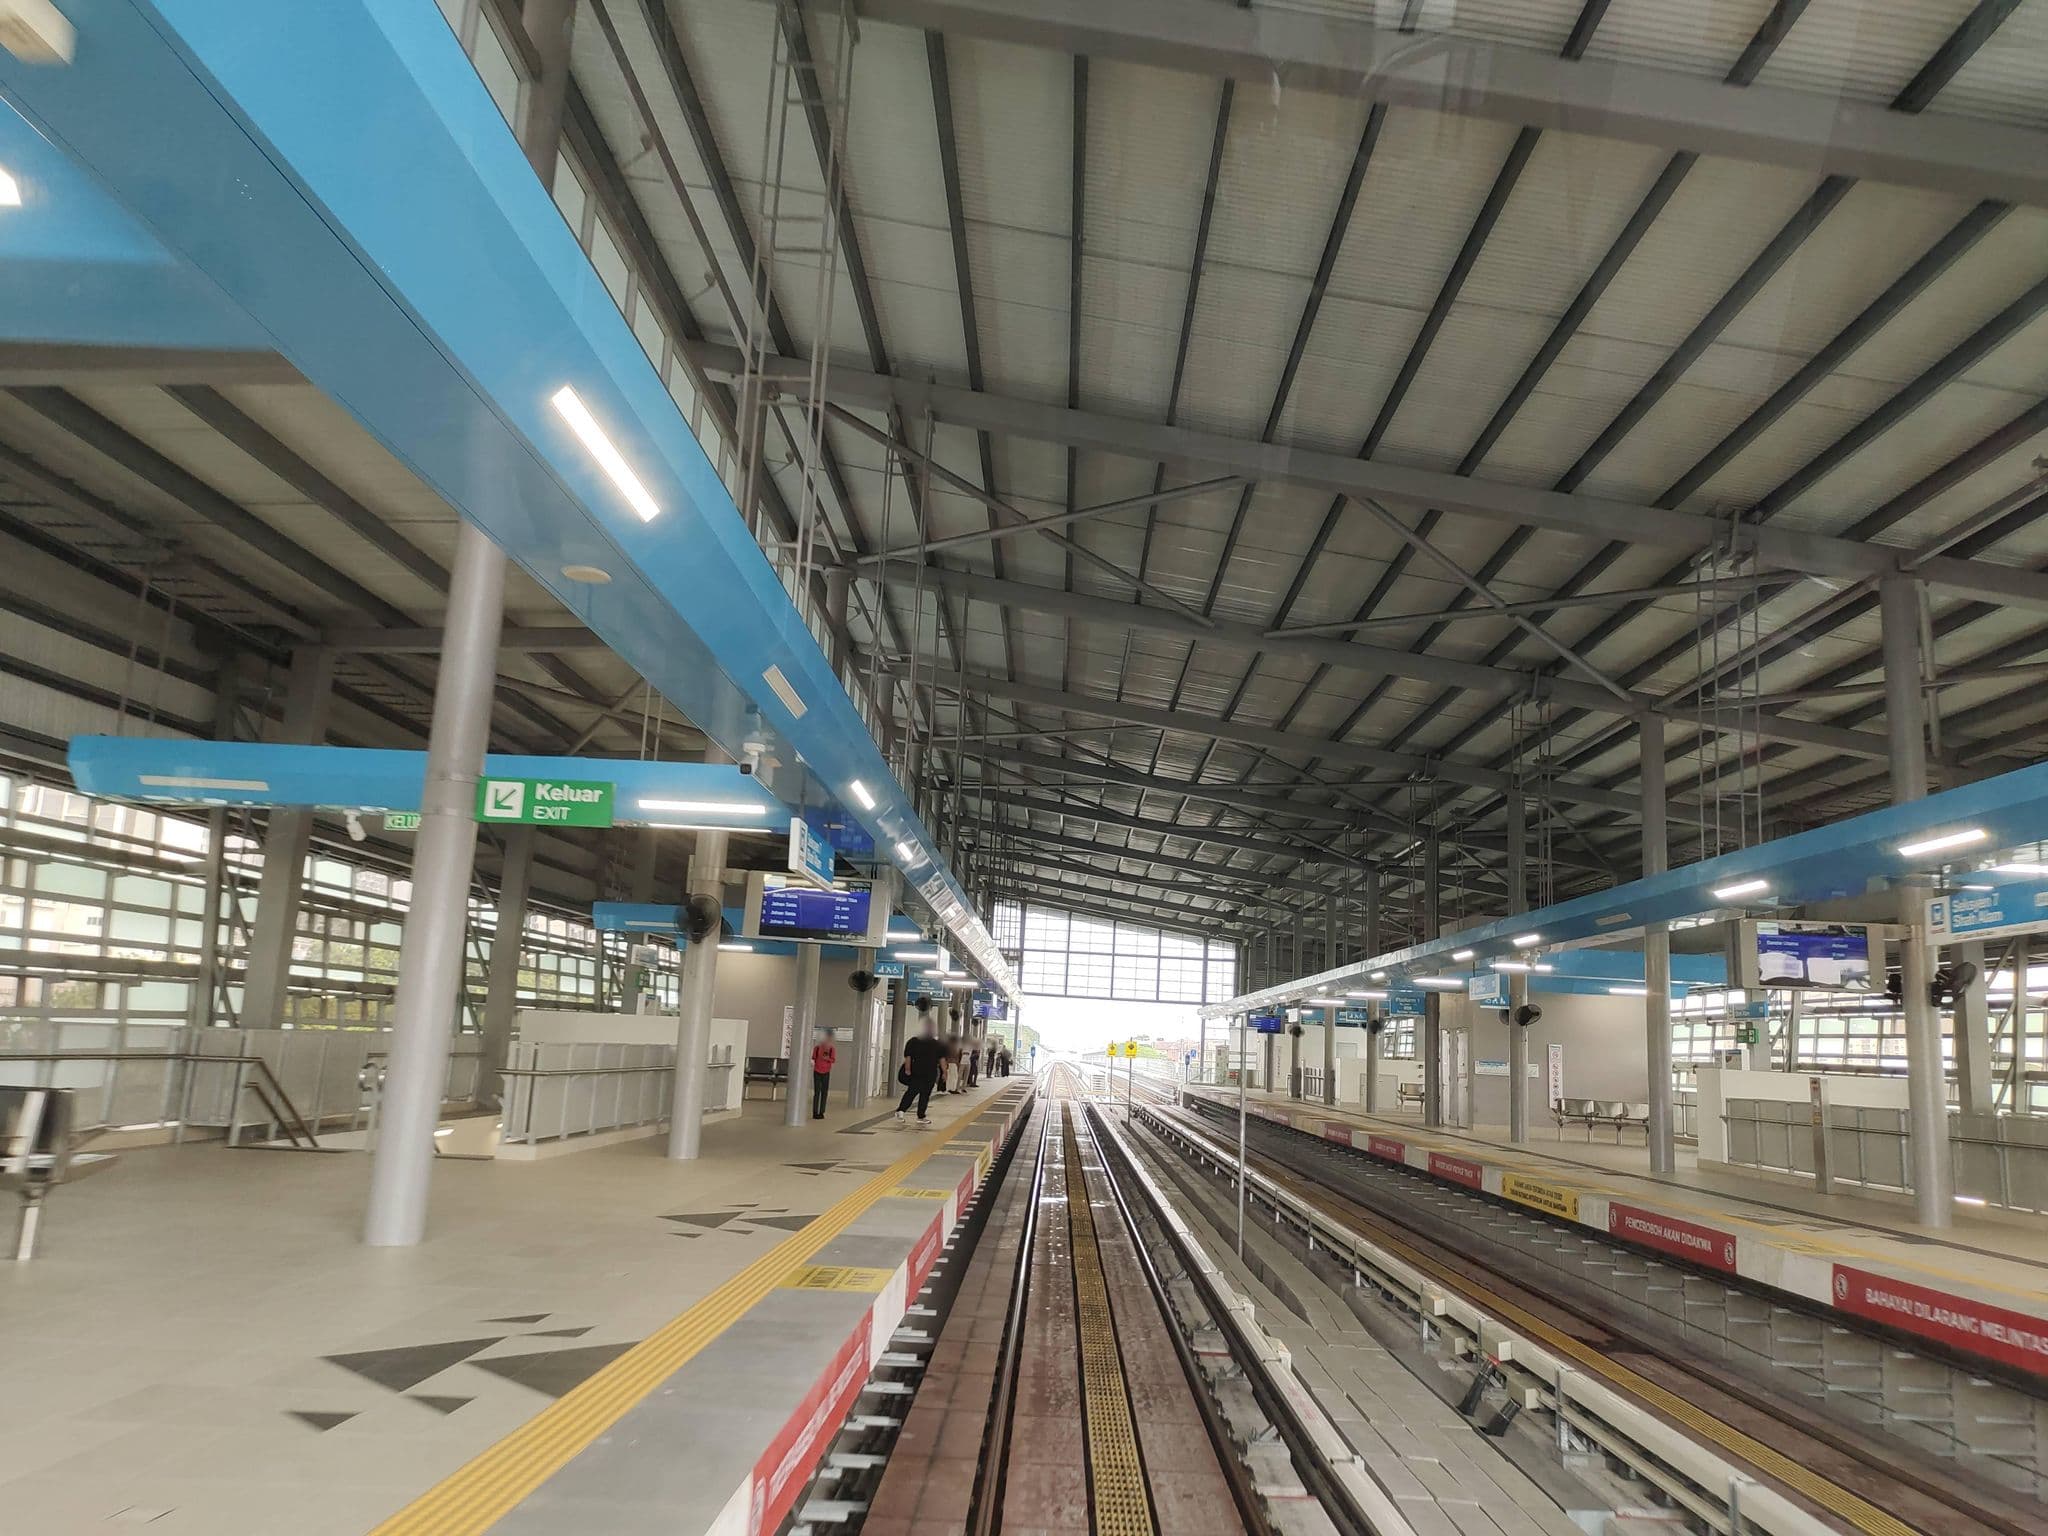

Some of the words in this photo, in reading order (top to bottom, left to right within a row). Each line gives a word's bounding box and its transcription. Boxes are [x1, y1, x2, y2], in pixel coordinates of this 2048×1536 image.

[534, 783, 603, 803] Keluar
[532, 805, 572, 820] EXIT
[1991, 892, 2000, 907] 7
[1952, 909, 1978, 928] Shah
[1979, 909, 2004, 923] Alam
[1663, 1227, 1681, 1243] AKAN
[1681, 1231, 1713, 1253] DIDAKWA
[1913, 1301, 1980, 1335] DILARANG
